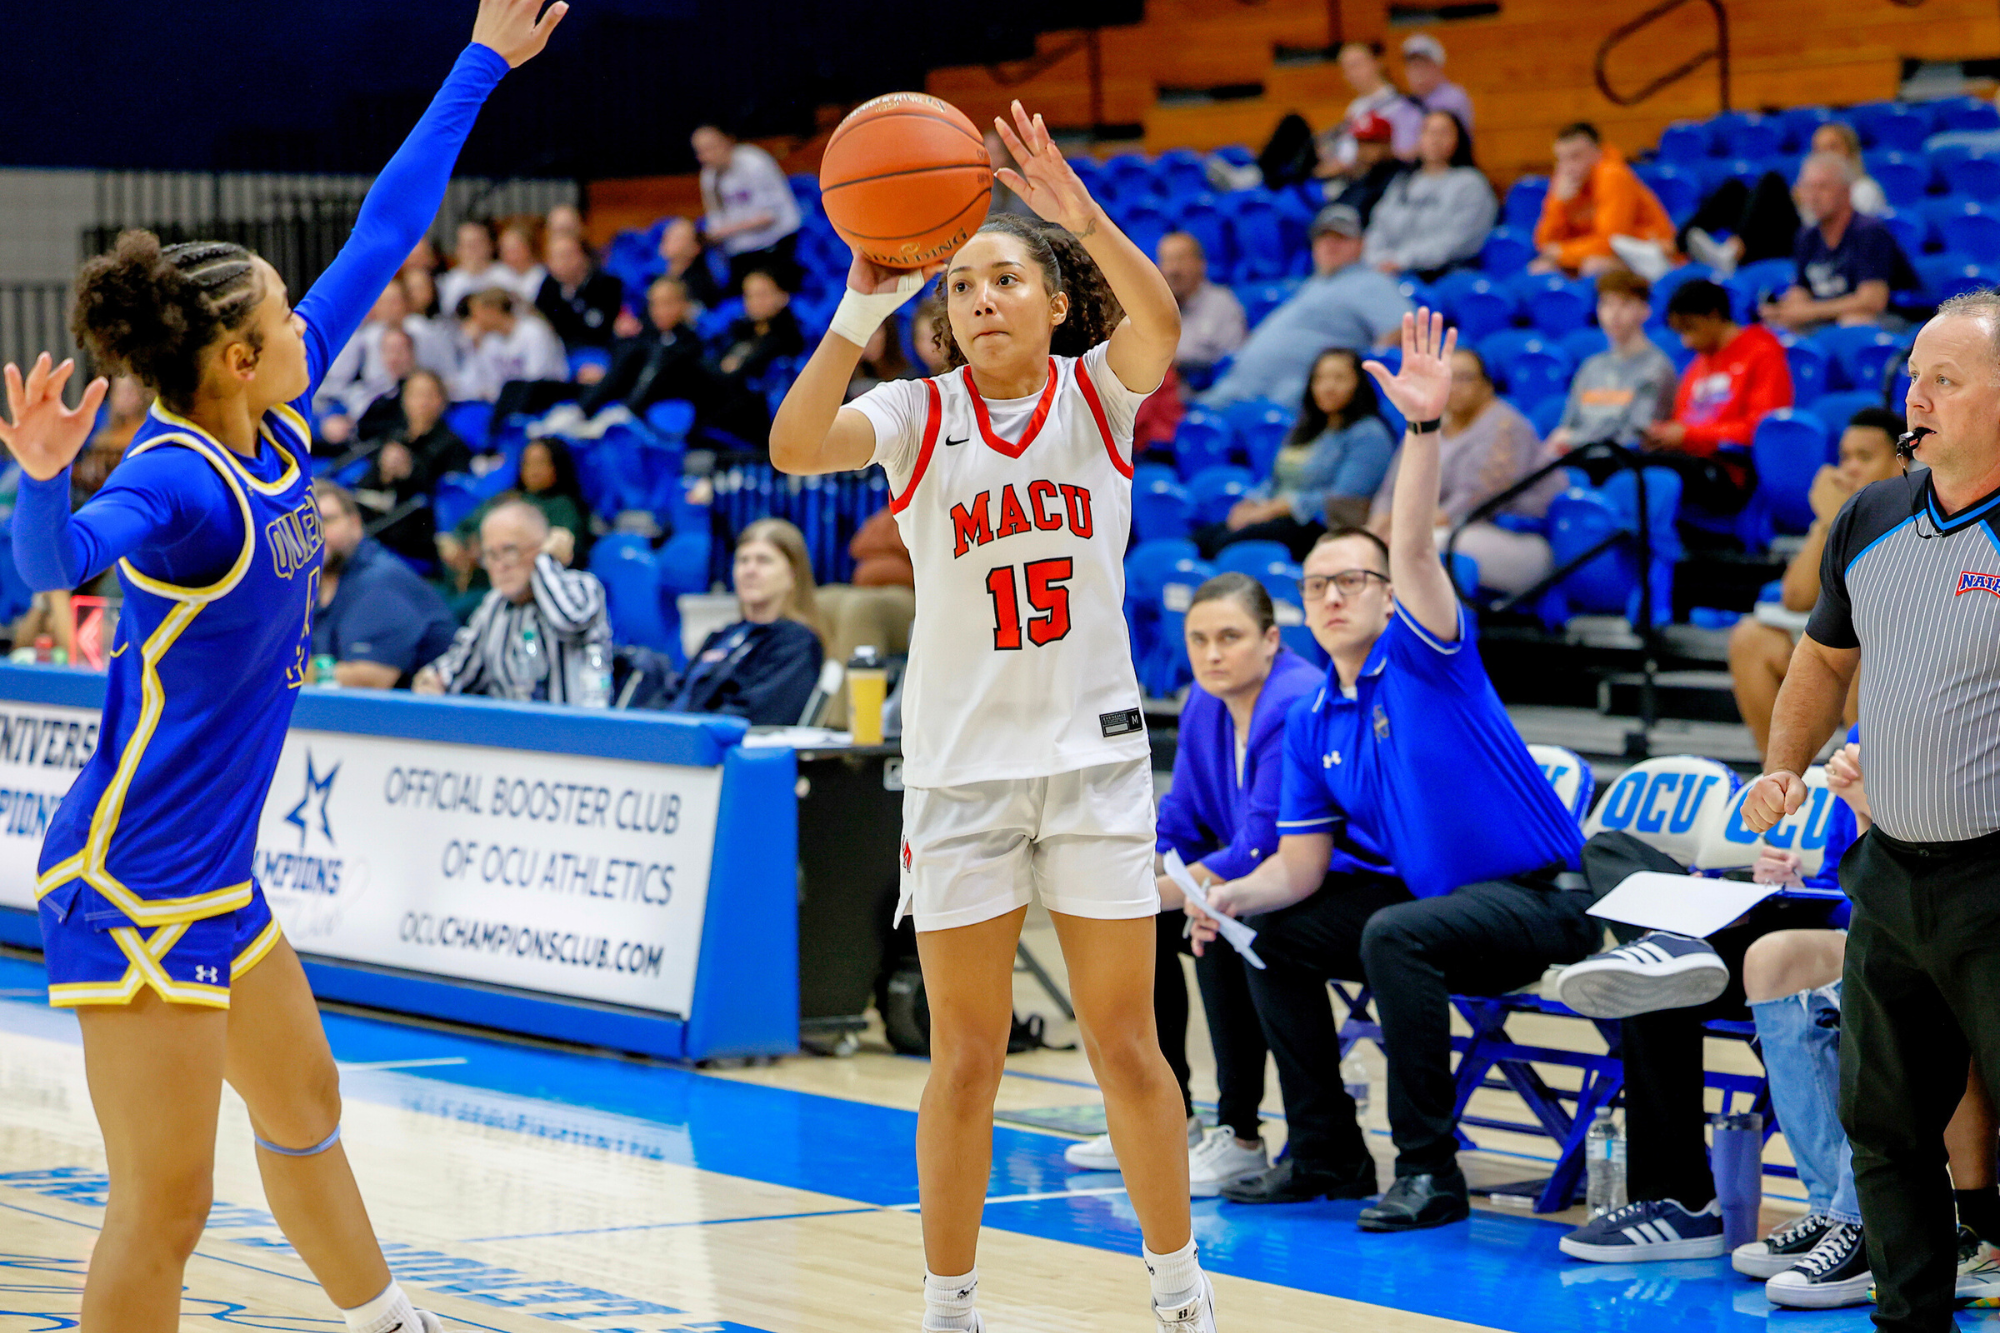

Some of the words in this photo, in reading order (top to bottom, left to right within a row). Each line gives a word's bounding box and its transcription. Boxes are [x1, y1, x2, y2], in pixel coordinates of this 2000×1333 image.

[950, 479, 1093, 560] MACU
[985, 556, 1073, 651] 15
[1131, 714, 1139, 725] M
[384, 766, 483, 814] OFFICIAL
[491, 777, 611, 827] BOOSTER
[615, 790, 682, 835] CLUB
[1601, 771, 1720, 834] OCU
[441, 840, 478, 879] OF
[482, 845, 538, 888] OCU
[541, 852, 675, 906] ATHLETICS
[400, 911, 665, 978] OCUCHAMPIONSCLUB.COM
